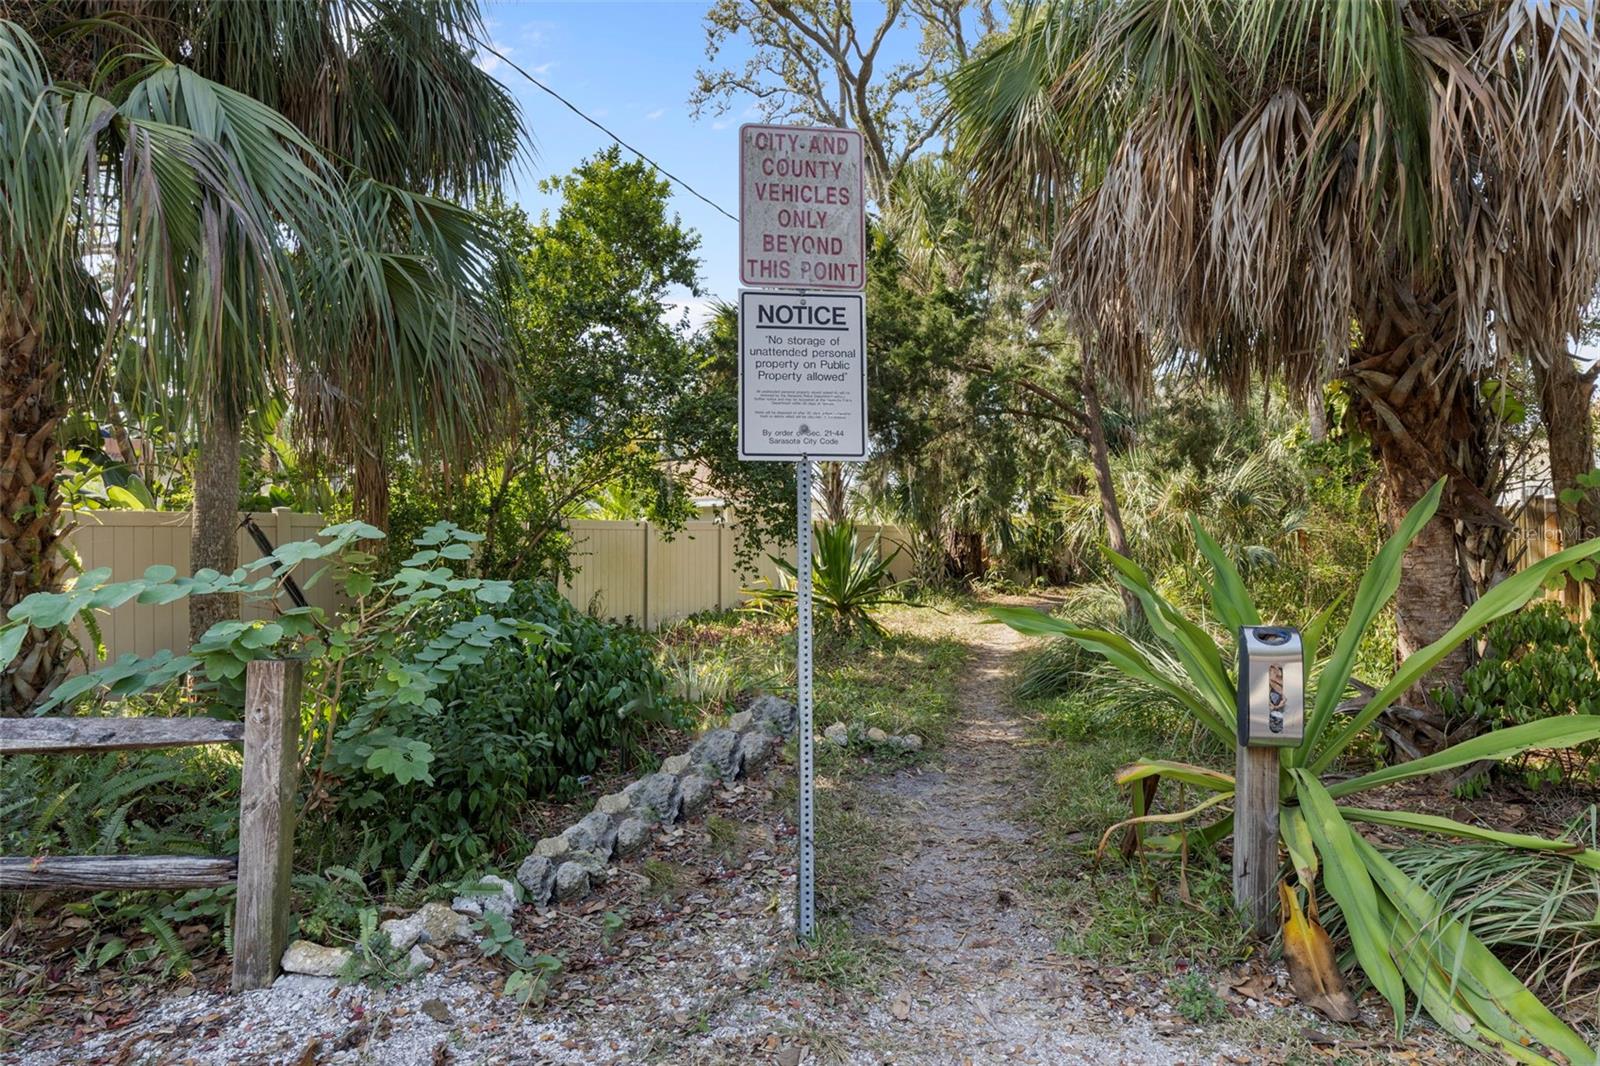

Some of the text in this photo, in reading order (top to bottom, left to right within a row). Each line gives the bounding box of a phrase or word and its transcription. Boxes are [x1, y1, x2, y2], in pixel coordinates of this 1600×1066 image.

[755, 132, 848, 155] CITY AND
[762, 158, 842, 178] COUNTY
[754, 182, 850, 205] VEHICLES
[778, 209, 828, 229] ONLY
[762, 234, 843, 255] BEYOND
[747, 260, 858, 282] THIS POINT
[758, 304, 846, 326] NOTICE
[787, 336, 826, 347] storage
[830, 336, 840, 346] of
[750, 348, 856, 358] unattended personal
[755, 360, 799, 370] property
[820, 360, 850, 370] Public
[758, 371, 801, 382] Property
[762, 429, 772, 437] By
[803, 437, 817, 446] City
